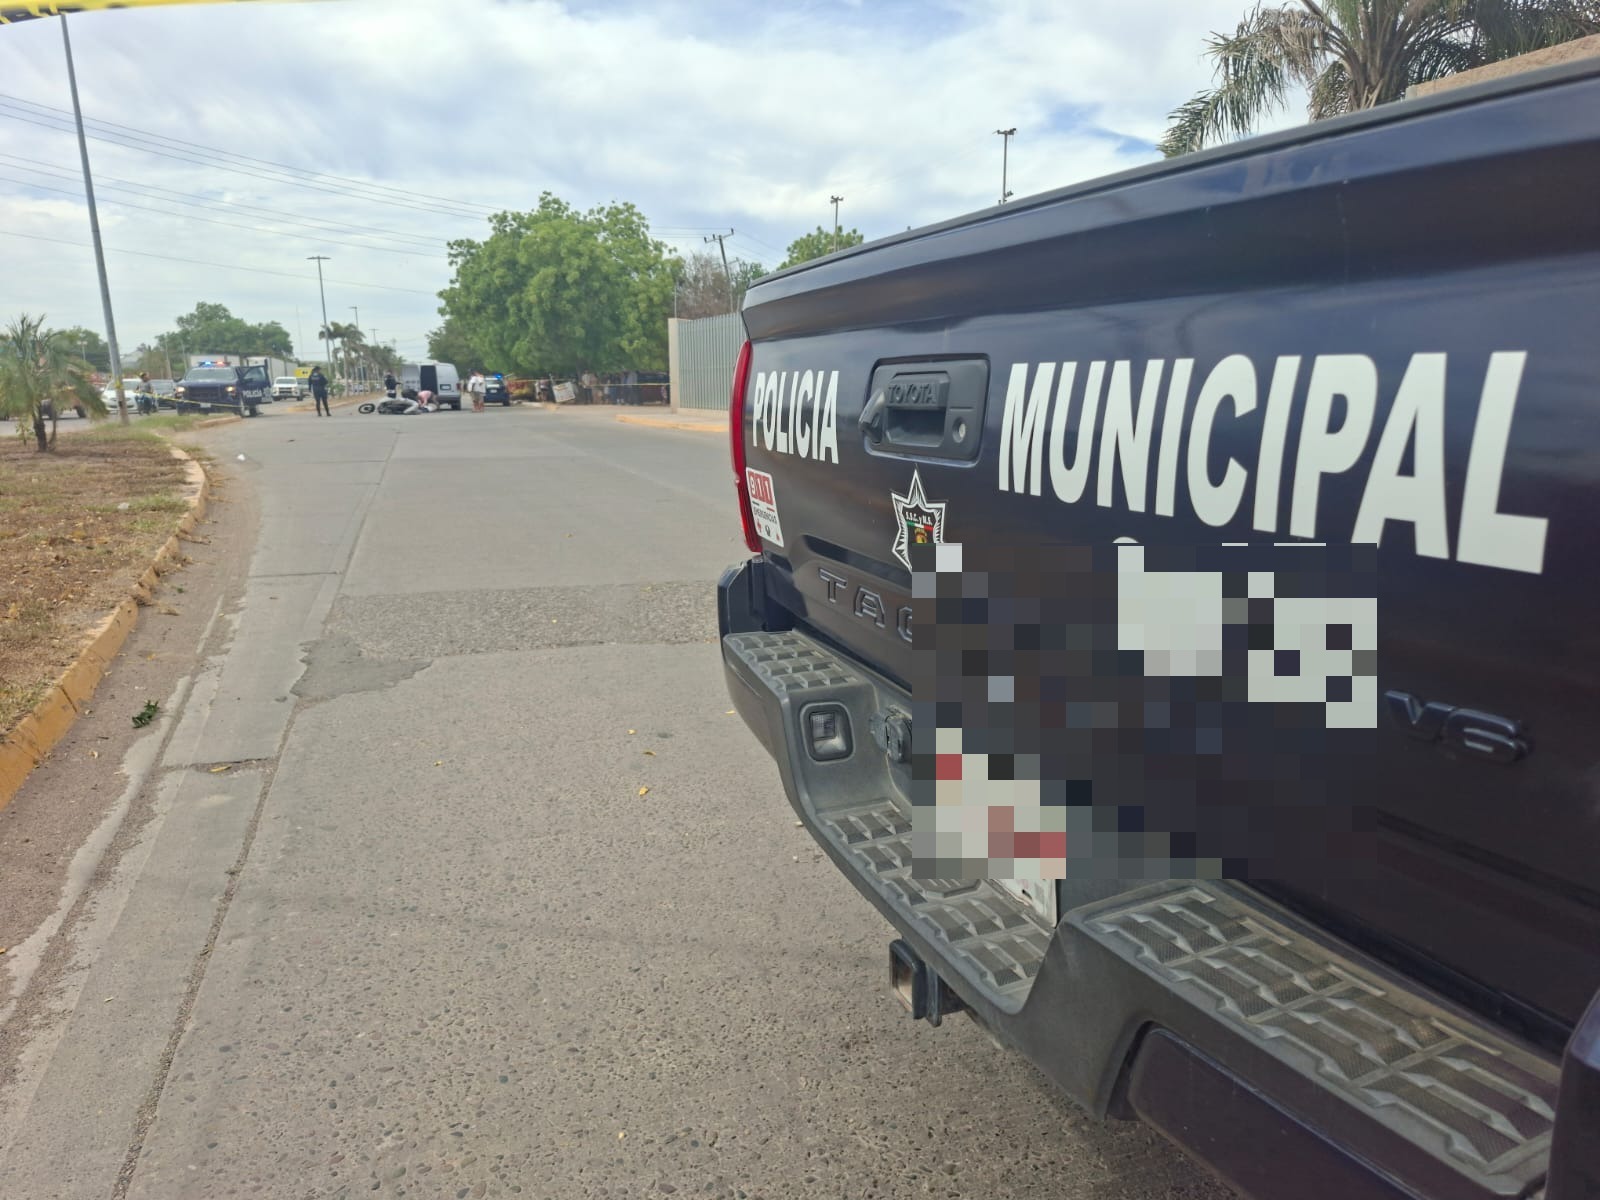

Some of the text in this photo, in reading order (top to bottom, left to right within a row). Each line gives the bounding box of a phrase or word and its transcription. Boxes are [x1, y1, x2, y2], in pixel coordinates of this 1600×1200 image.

[888, 383, 937, 404] TOYOTA
[753, 351, 1549, 574] POLICIA MUNICIPAL
[749, 474, 772, 502] 911
